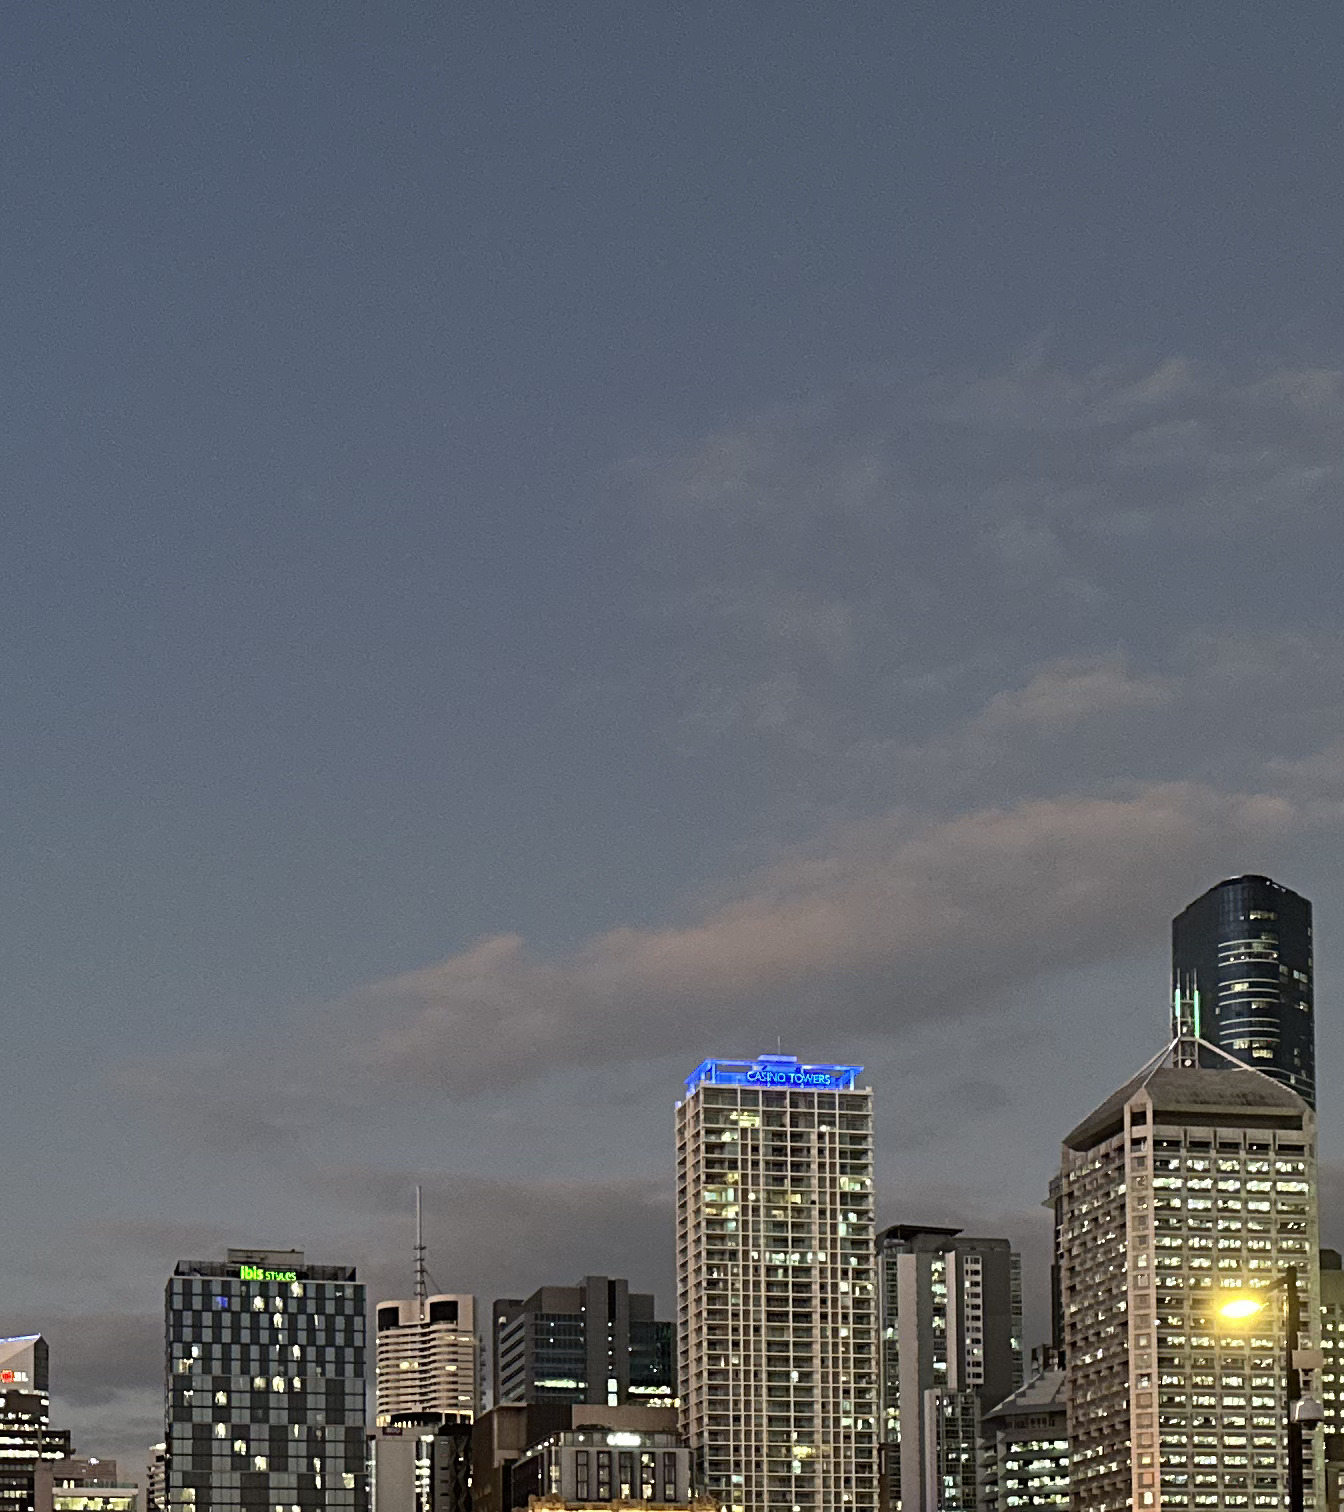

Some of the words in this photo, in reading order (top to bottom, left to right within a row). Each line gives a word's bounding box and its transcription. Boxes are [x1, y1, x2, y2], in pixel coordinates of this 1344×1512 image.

[747, 1070, 786, 1083] CASINO
[788, 1073, 831, 1085] TOWERS
[240, 1265, 264, 1280] ibis
